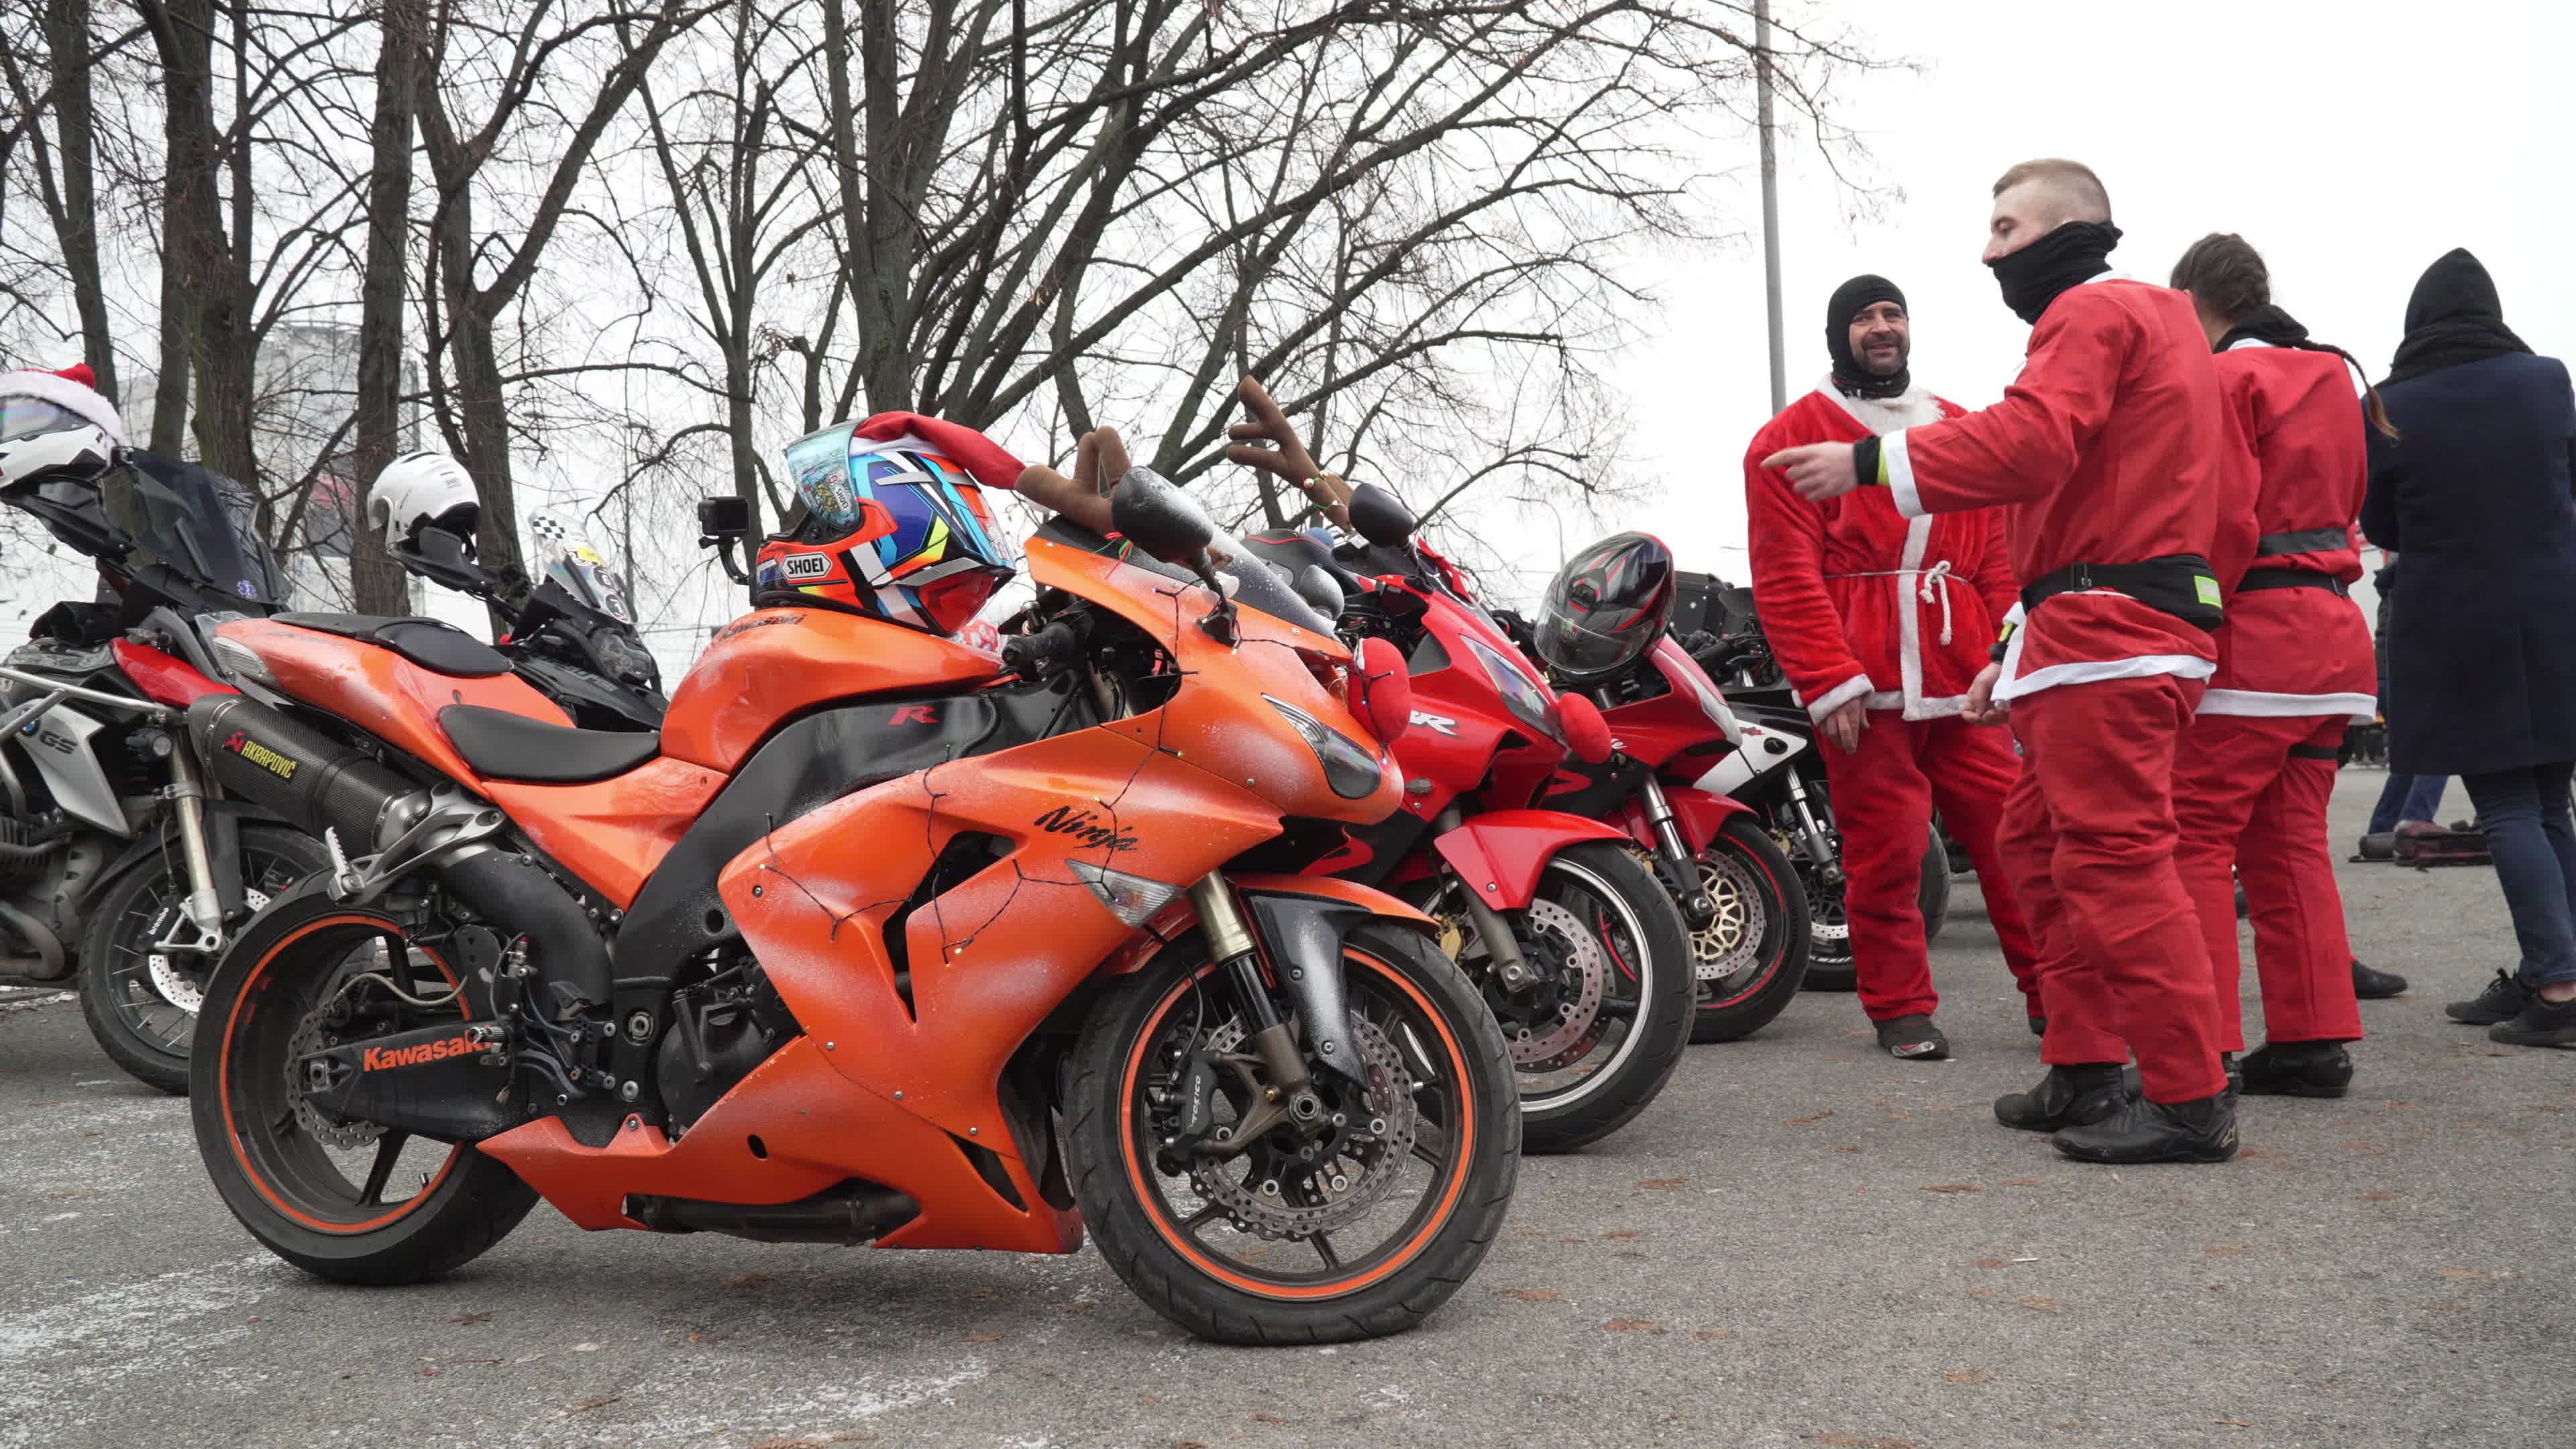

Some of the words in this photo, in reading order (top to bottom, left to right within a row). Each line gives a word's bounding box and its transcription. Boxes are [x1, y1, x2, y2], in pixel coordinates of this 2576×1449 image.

[835, 488, 849, 509] SHOEI
[787, 557, 824, 575] SHOEI
[888, 705, 940, 725] R
[40, 730, 78, 755] GS
[1034, 806, 1138, 851] Ninja
[147, 907, 169, 935] brembo
[1191, 1075, 1201, 1123] TOKICO
